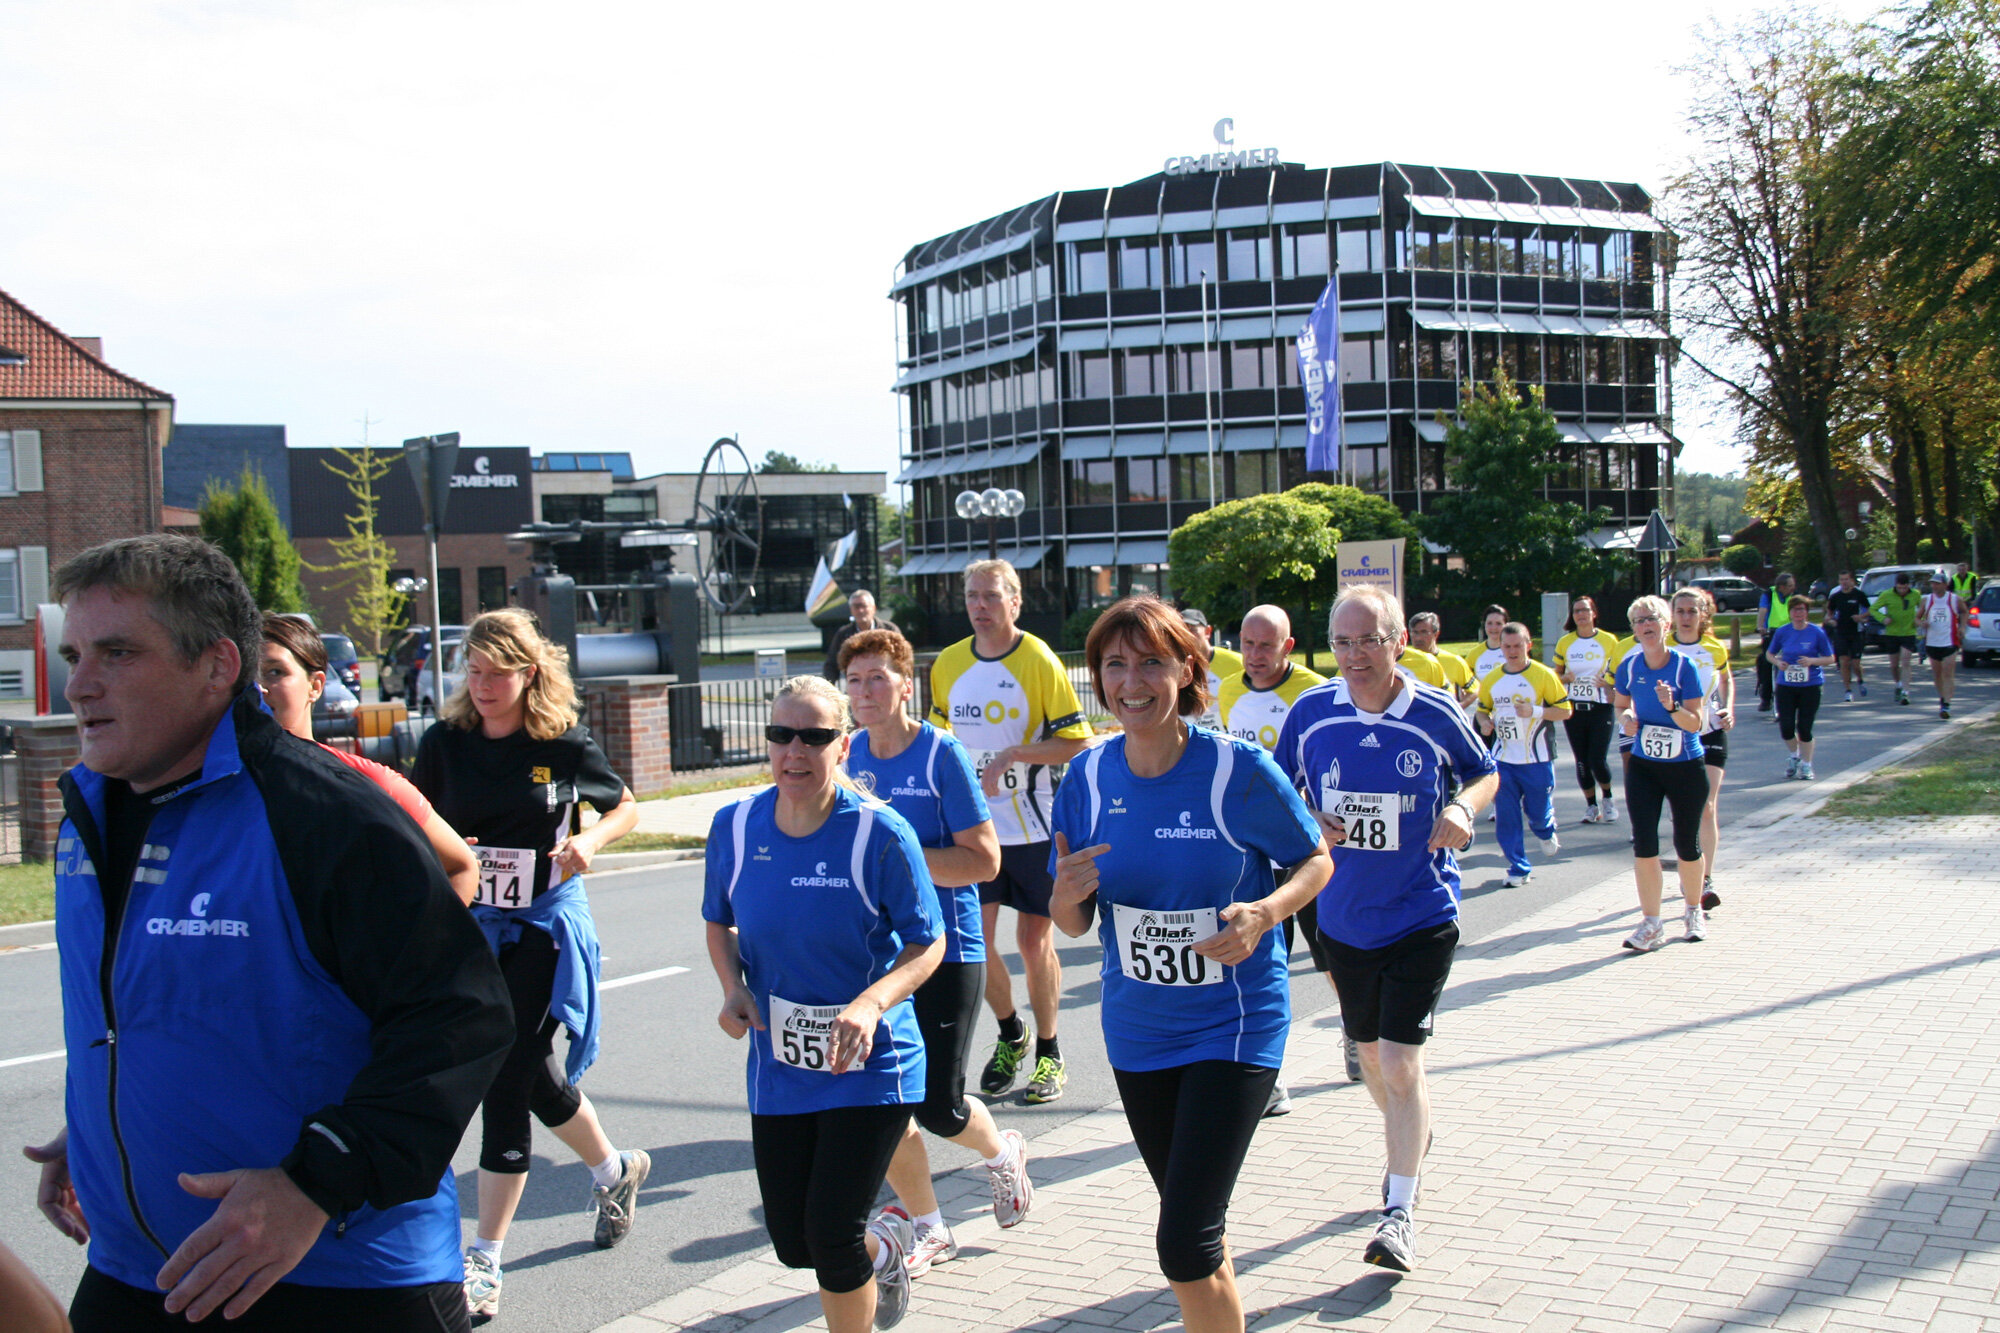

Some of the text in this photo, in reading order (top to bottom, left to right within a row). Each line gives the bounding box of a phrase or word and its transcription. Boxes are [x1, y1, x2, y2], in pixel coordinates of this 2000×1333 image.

[1163, 147, 1279, 176] CRAEMER
[1341, 567, 1389, 577] CRAEMER
[1787, 672, 1804, 682] 649
[1573, 685, 1593, 697] 526
[954, 703, 981, 718] sita
[1232, 728, 1256, 742] sita
[1498, 725, 1518, 740] 551
[1645, 740, 1672, 758] 531
[891, 787, 931, 797] CRAEMER
[1154, 827, 1217, 840] CRAEMER
[791, 877, 850, 888] CRAEMER
[146, 917, 250, 937] CRAEMER
[1145, 926, 1196, 938] Olafs
[1130, 940, 1206, 985] 530
[782, 1029, 829, 1070] 55
